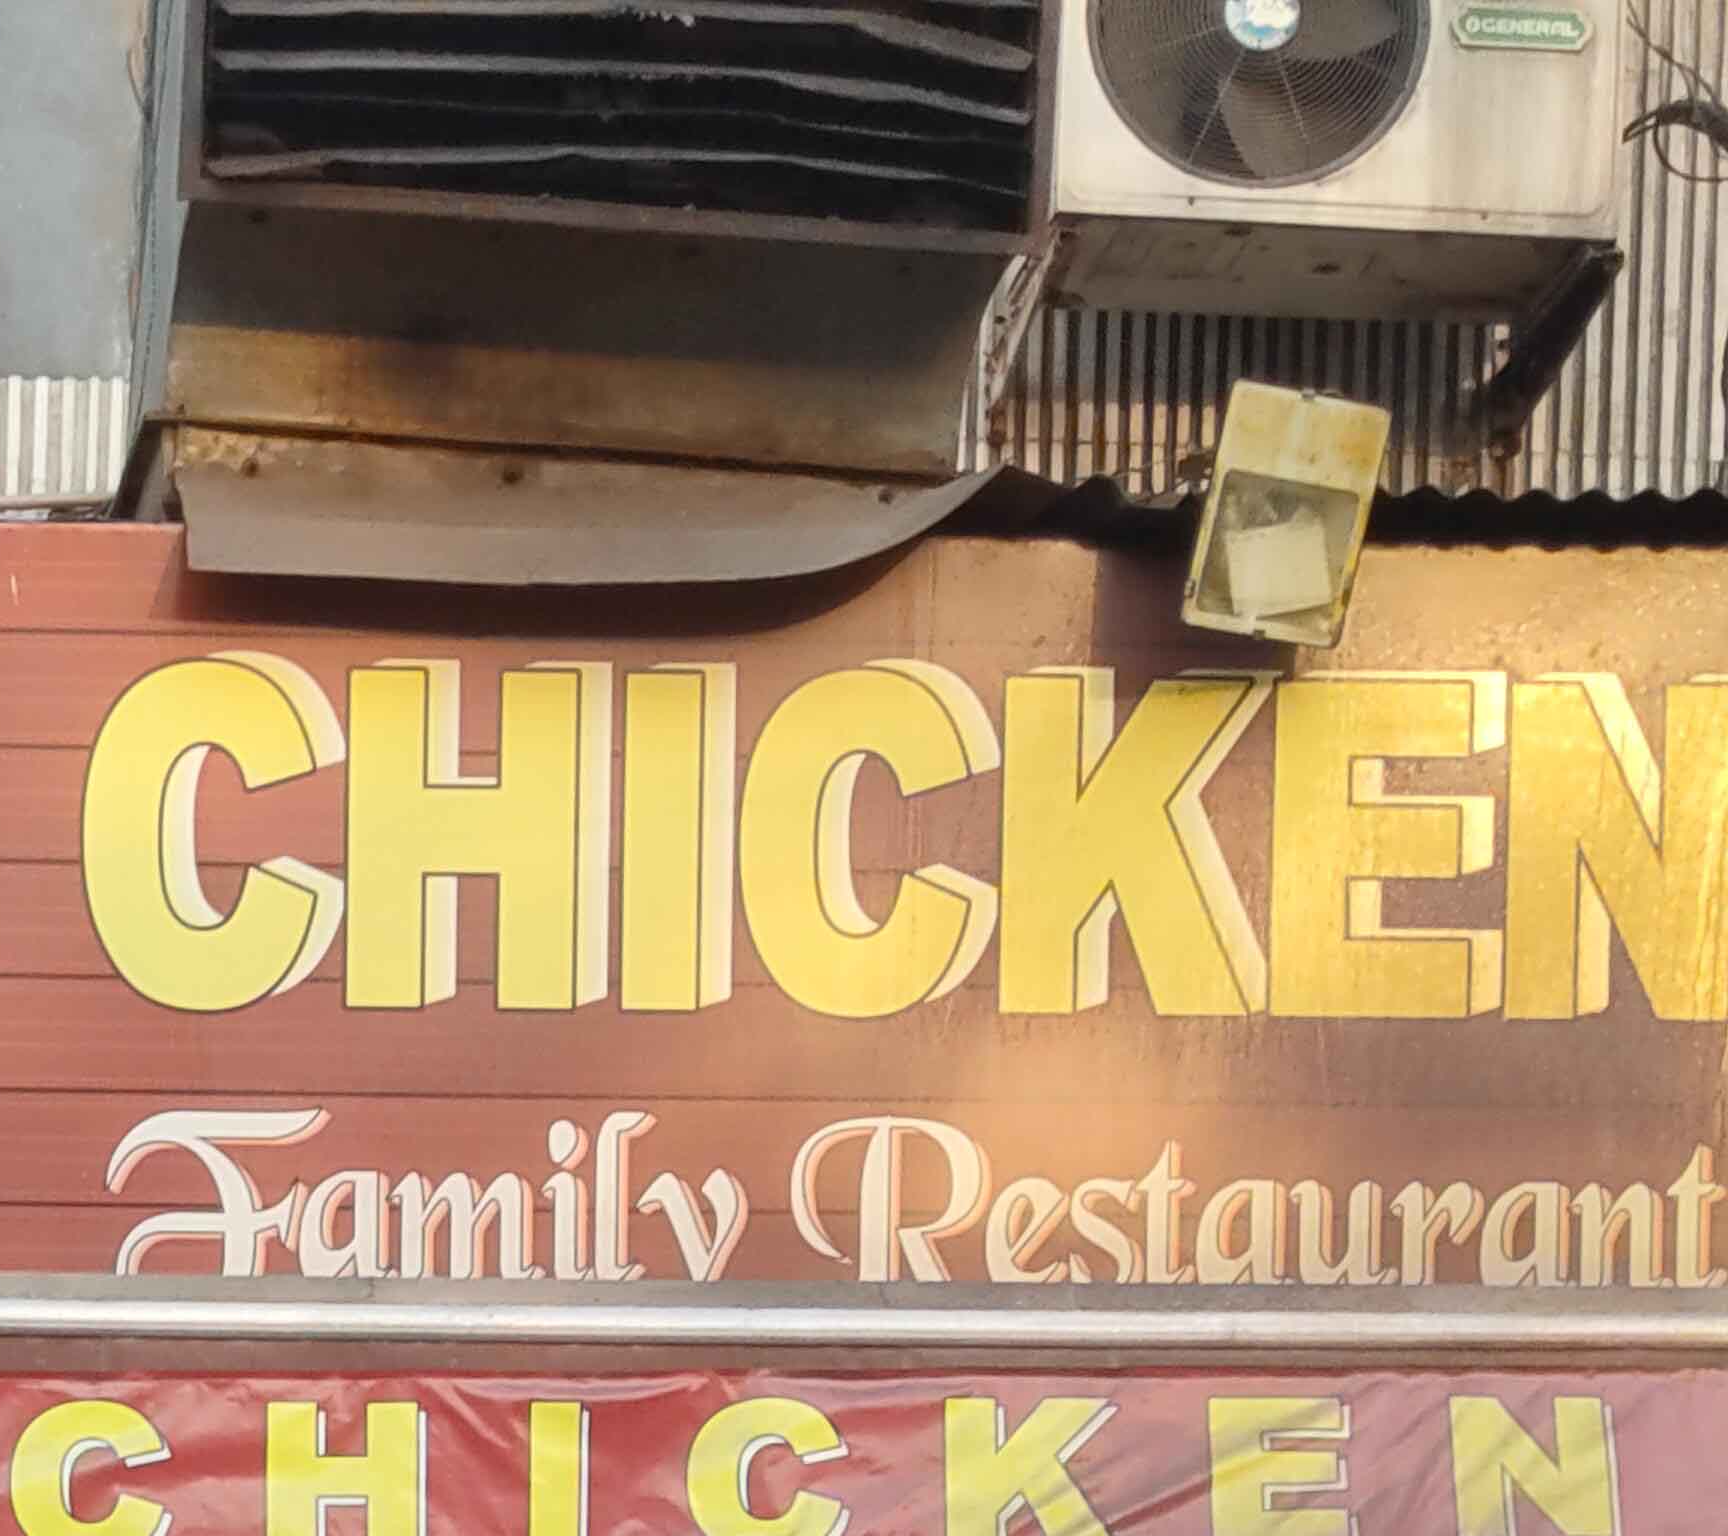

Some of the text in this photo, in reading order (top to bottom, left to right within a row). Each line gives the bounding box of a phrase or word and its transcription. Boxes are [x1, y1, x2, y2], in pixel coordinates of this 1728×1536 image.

[81, 649, 1728, 1021] CHICKEN
[105, 1107, 1724, 1291] Family Restaurant
